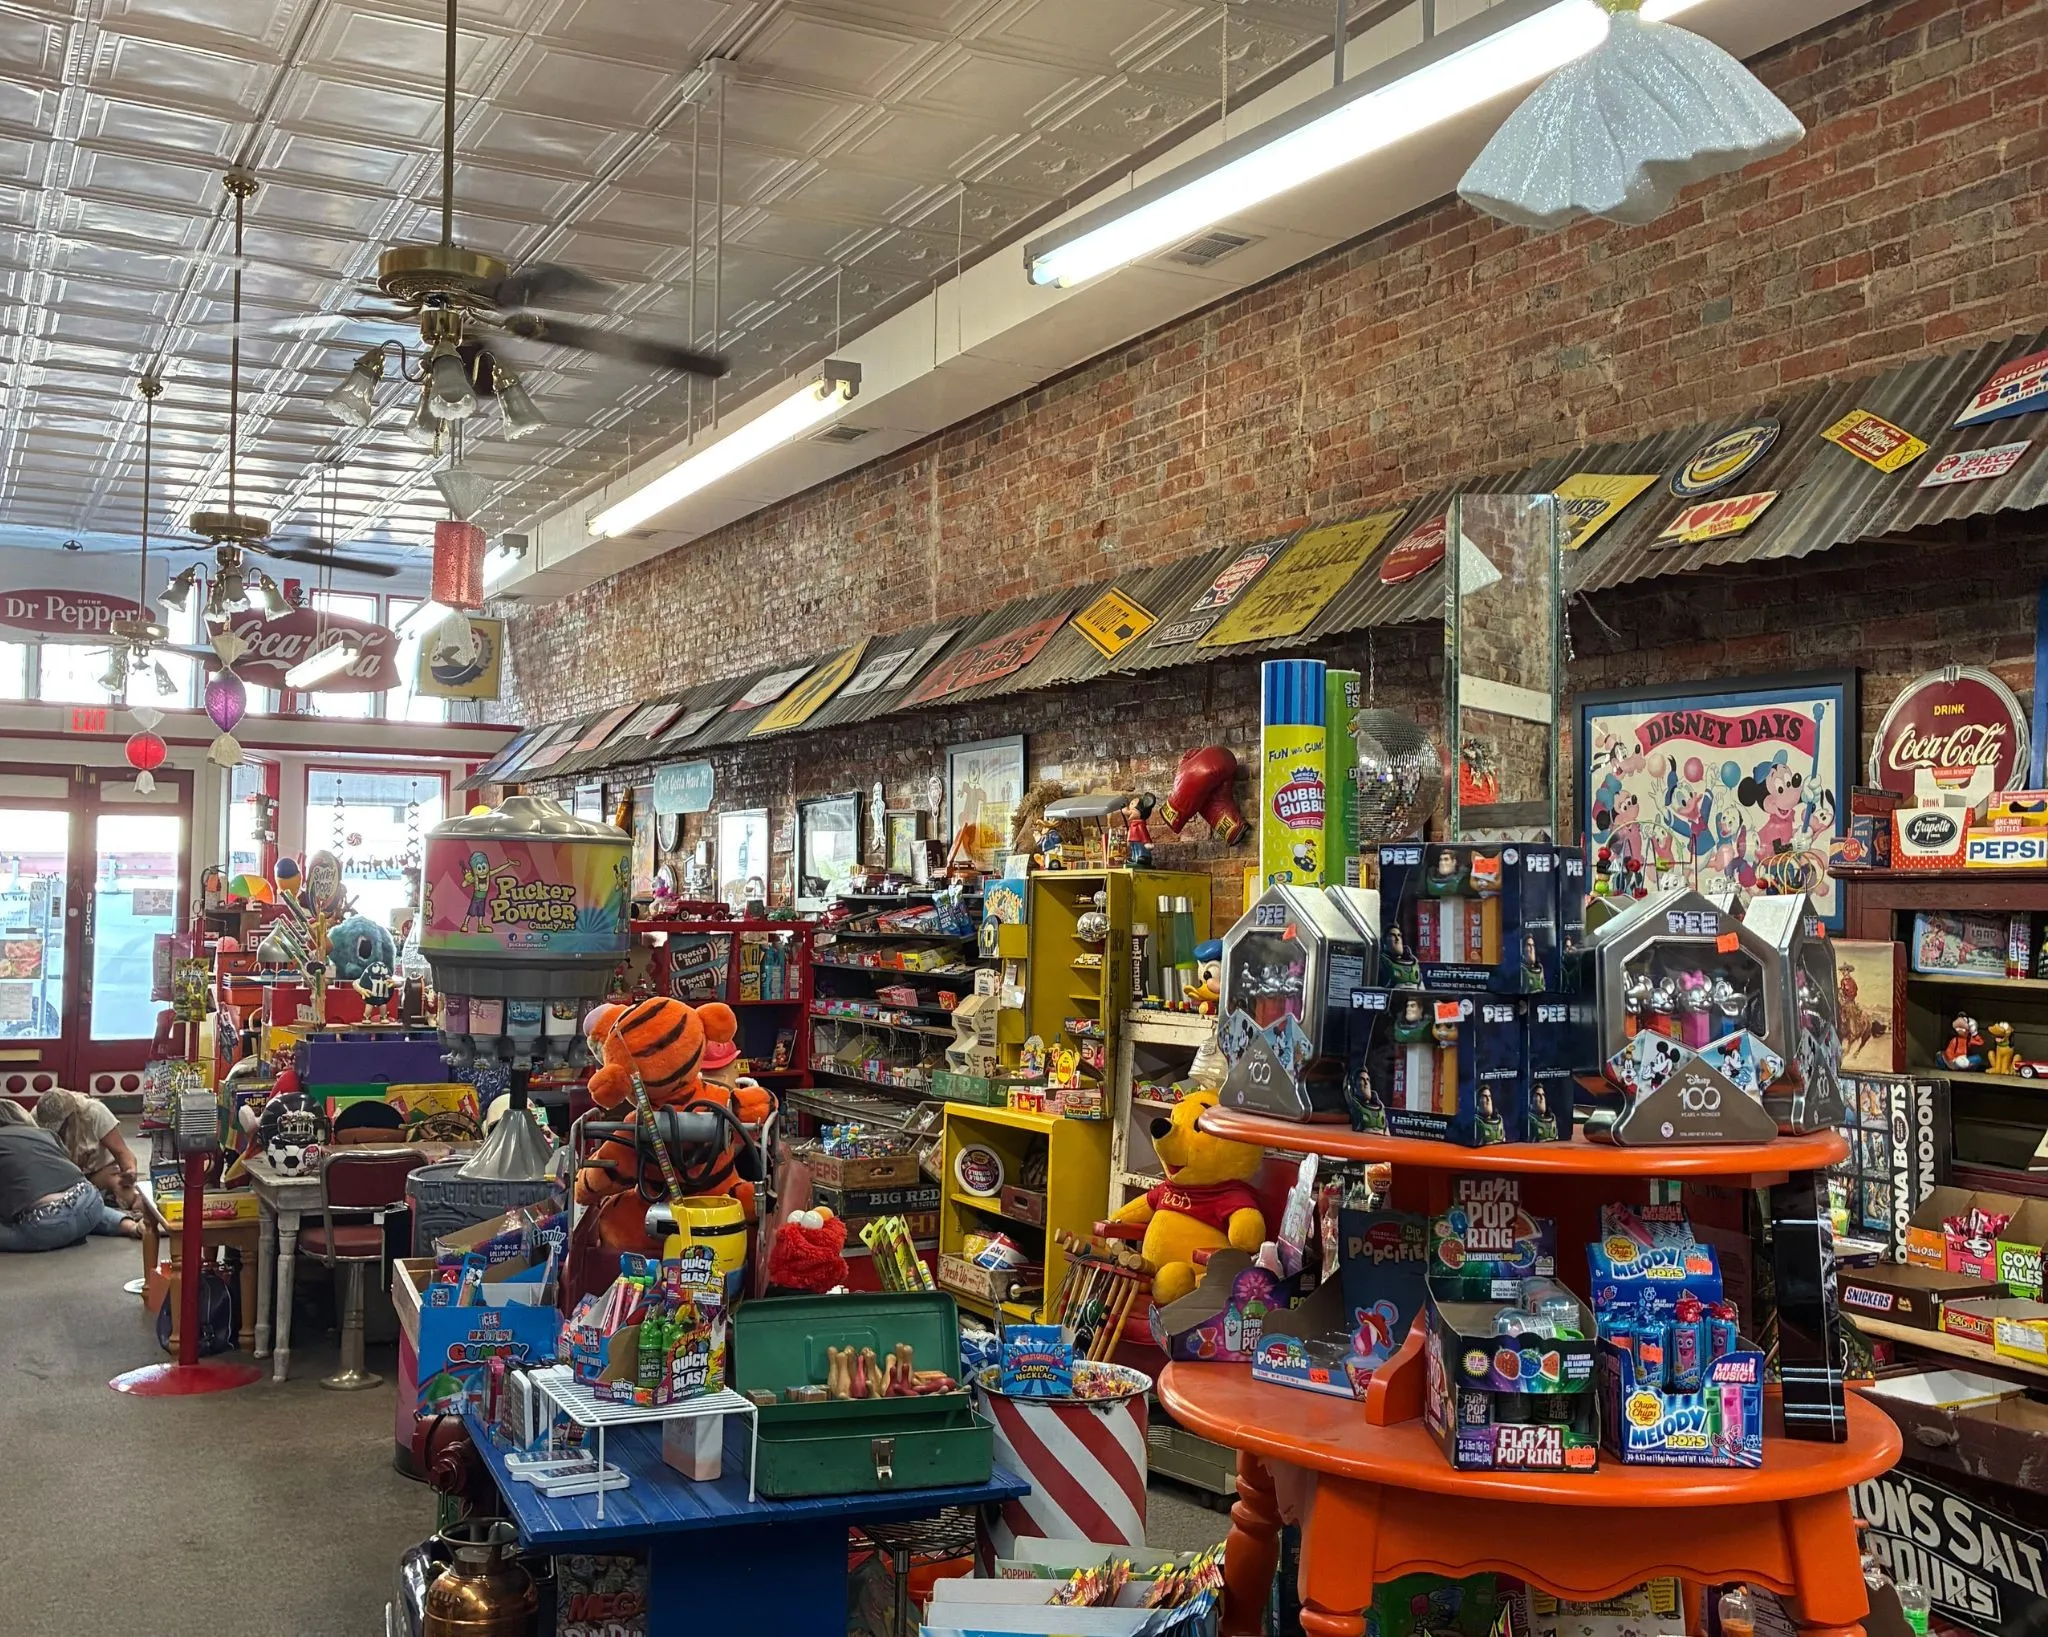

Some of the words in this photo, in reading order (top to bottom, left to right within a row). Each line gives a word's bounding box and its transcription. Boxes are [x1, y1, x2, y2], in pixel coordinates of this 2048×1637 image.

[1966, 451, 2019, 467] PIECE
[1952, 467, 1976, 480] OF
[1714, 494, 1776, 521] MY
[1276, 535, 1371, 574] SCHOOL
[1253, 586, 1322, 619] ZONE
[6, 598, 39, 619] Dr
[45, 596, 138, 630] Pepper
[234, 620, 388, 678] Coca-Cla
[1934, 703, 1965, 717] DRINK
[72, 708, 107, 732] EXIT
[1646, 711, 1733, 748] DISNEY
[1739, 711, 1804, 744] DAYS
[1268, 748, 1289, 763] FUN
[1889, 722, 2006, 770] Coca-Cola
[1280, 801, 1325, 818] BUBBL
[1923, 798, 1940, 808] DRINK
[1911, 820, 1951, 840] Grapette
[1994, 825, 2020, 833] BOTTLES
[1381, 847, 1421, 866] PEZ
[1969, 840, 2045, 860] PEPSI
[1526, 853, 1551, 872] PEZ
[1566, 858, 1583, 877] PEZ
[496, 876, 577, 902] Pucker
[1256, 904, 1285, 925] PEZ
[1668, 911, 1719, 934] PEZ
[529, 921, 559, 932] Candy
[561, 921, 576, 930] Art
[1420, 914, 1433, 947] PEZ
[1471, 913, 1481, 947] PEZ
[676, 944, 708, 961] Tootsie
[685, 955, 703, 967] Roll
[680, 972, 711, 986] Tootsie
[1427, 969, 1490, 980] LIGHTYEAR
[1352, 992, 1387, 1010] PEZ
[1483, 1005, 1514, 1023] PEZ
[1537, 1005, 1568, 1023] PEZ
[1685, 1072, 1711, 1087] Disney
[1678, 1087, 1721, 1111] 100
[1392, 1116, 1449, 1130] LIGHTYEAR
[1917, 1085, 1935, 1203] NOCONA
[203, 1200, 238, 1211] ANDY
[869, 1192, 902, 1206] BIG
[905, 1188, 941, 1203] RED
[1468, 1202, 1517, 1229] POP
[1894, 1168, 1910, 1265] OCONA
[1467, 1228, 1513, 1249] RING
[1613, 1247, 1679, 1279] MELODY
[2002, 1251, 2041, 1270] COW
[680, 1271, 711, 1285] BLAST
[943, 1260, 959, 1282] Fresh
[1647, 1268, 1685, 1279] POPS
[2002, 1265, 2043, 1286] TALES
[1846, 1288, 1891, 1309] SNICKERS
[1948, 1311, 1987, 1335] ZAGNUT
[449, 1344, 529, 1363] GUMMY
[1242, 1337, 1259, 1351] PO
[1021, 1364, 1050, 1373] CANDY
[1257, 1351, 1307, 1369] POPCIFIER
[1715, 1363, 1731, 1373] PLAY
[1732, 1362, 1749, 1372] REAL
[671, 1368, 708, 1391] BLAST
[1015, 1371, 1057, 1382] NECKLACE
[1467, 1403, 1486, 1416] POP
[1632, 1408, 1657, 1421] Chups
[1633, 1400, 1658, 1411] Chupa
[1466, 1415, 1486, 1424] RING
[1631, 1407, 1709, 1447] MELODY
[1667, 1435, 1707, 1447] POPS
[1497, 1448, 1526, 1463] POP
[1528, 1449, 1561, 1464] RING
[1943, 1497, 2048, 1598] SALT
[1001, 1567, 1036, 1579] POPPING
[1866, 1531, 1994, 1615] POURS
[567, 1592, 642, 1622] MEG
